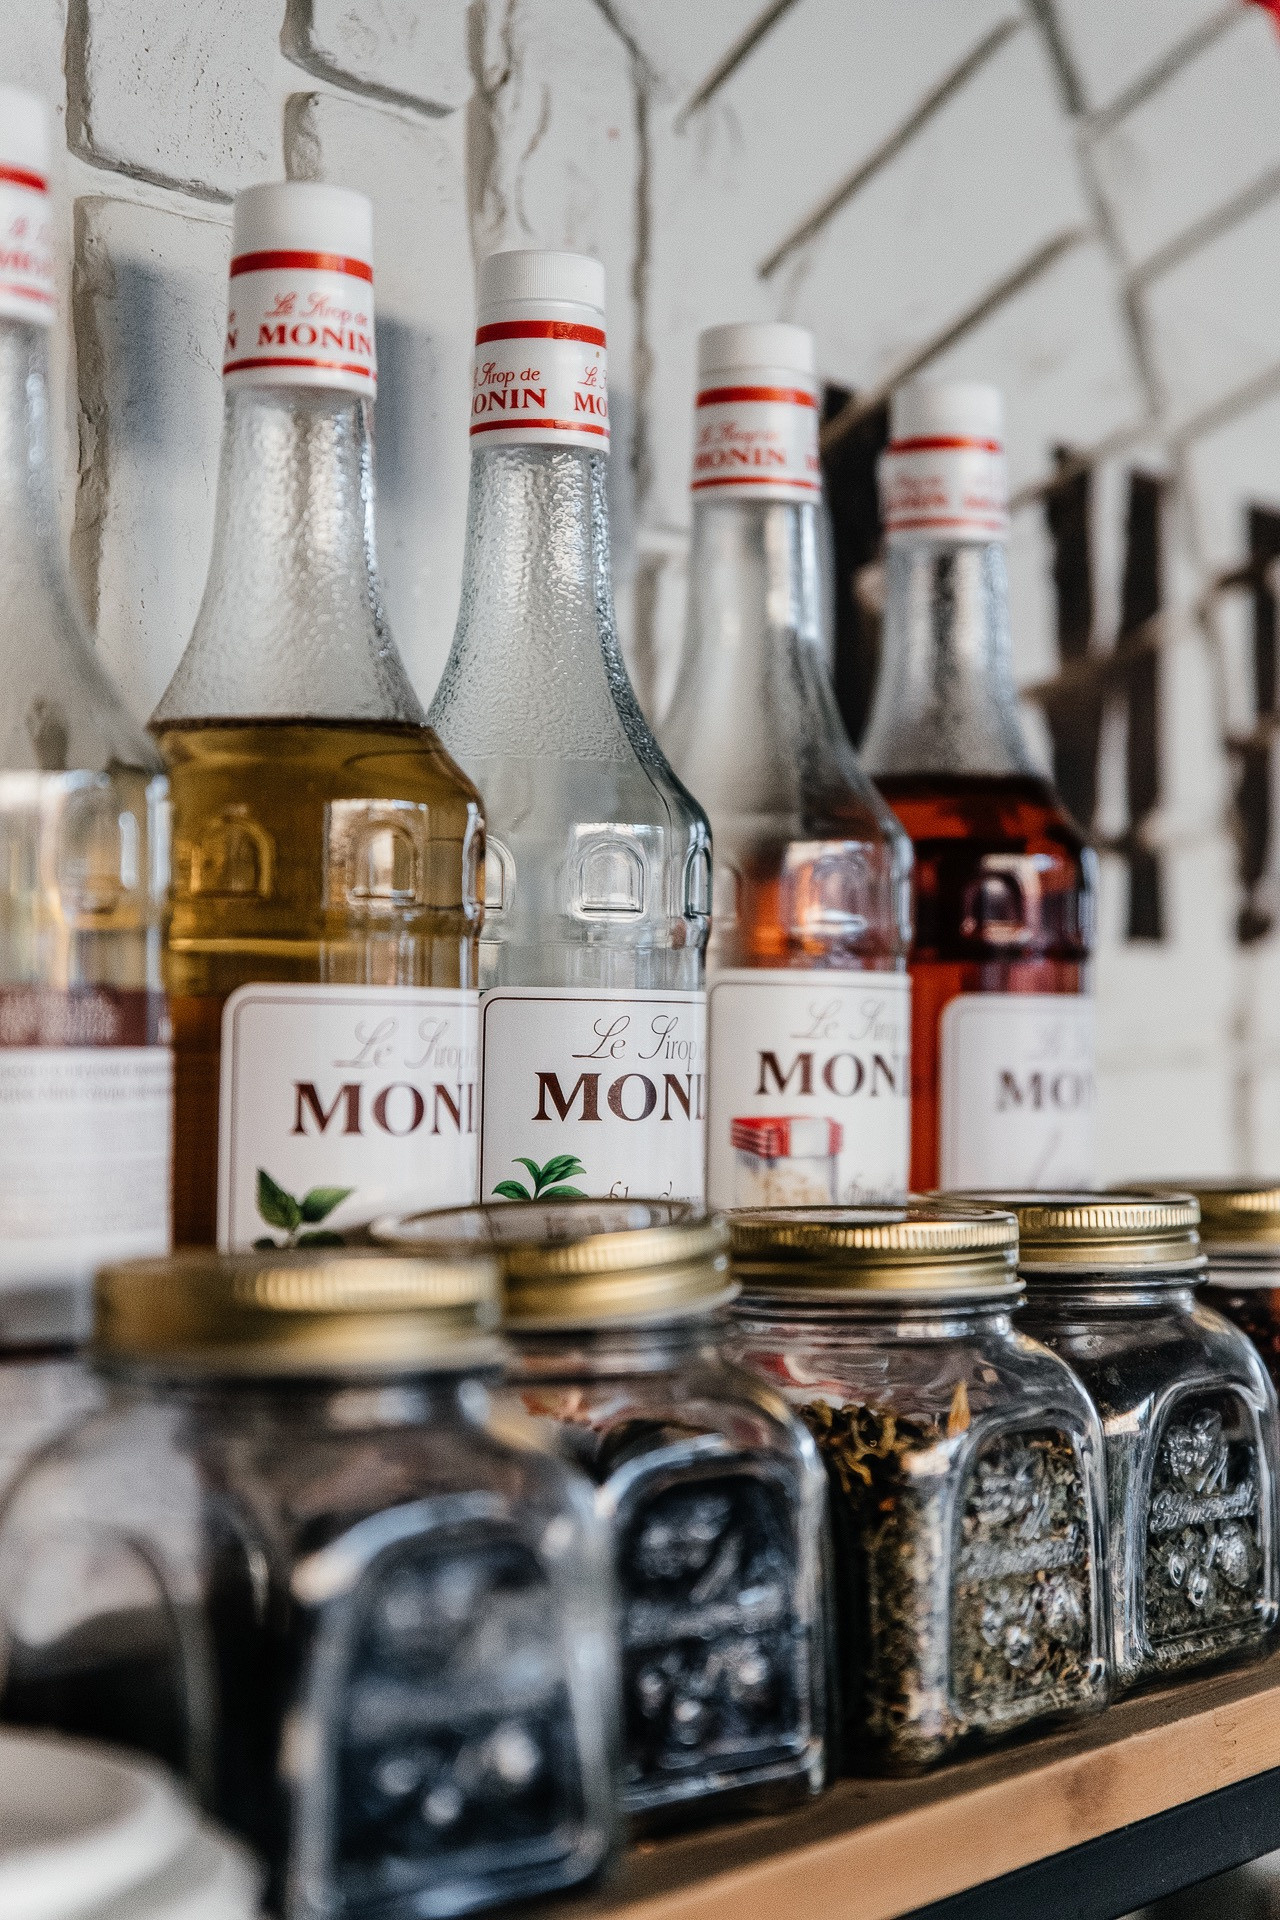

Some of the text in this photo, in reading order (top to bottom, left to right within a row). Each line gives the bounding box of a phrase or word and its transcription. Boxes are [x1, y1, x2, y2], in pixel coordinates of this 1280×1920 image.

[257, 322, 373, 356] MONIN
[478, 362, 515, 388] Sirop
[519, 367, 540, 381] de
[577, 365, 599, 388] Le
[471, 388, 547, 415] ONIN
[331, 1016, 396, 1069] Le
[572, 1015, 697, 1072] Le Sirop
